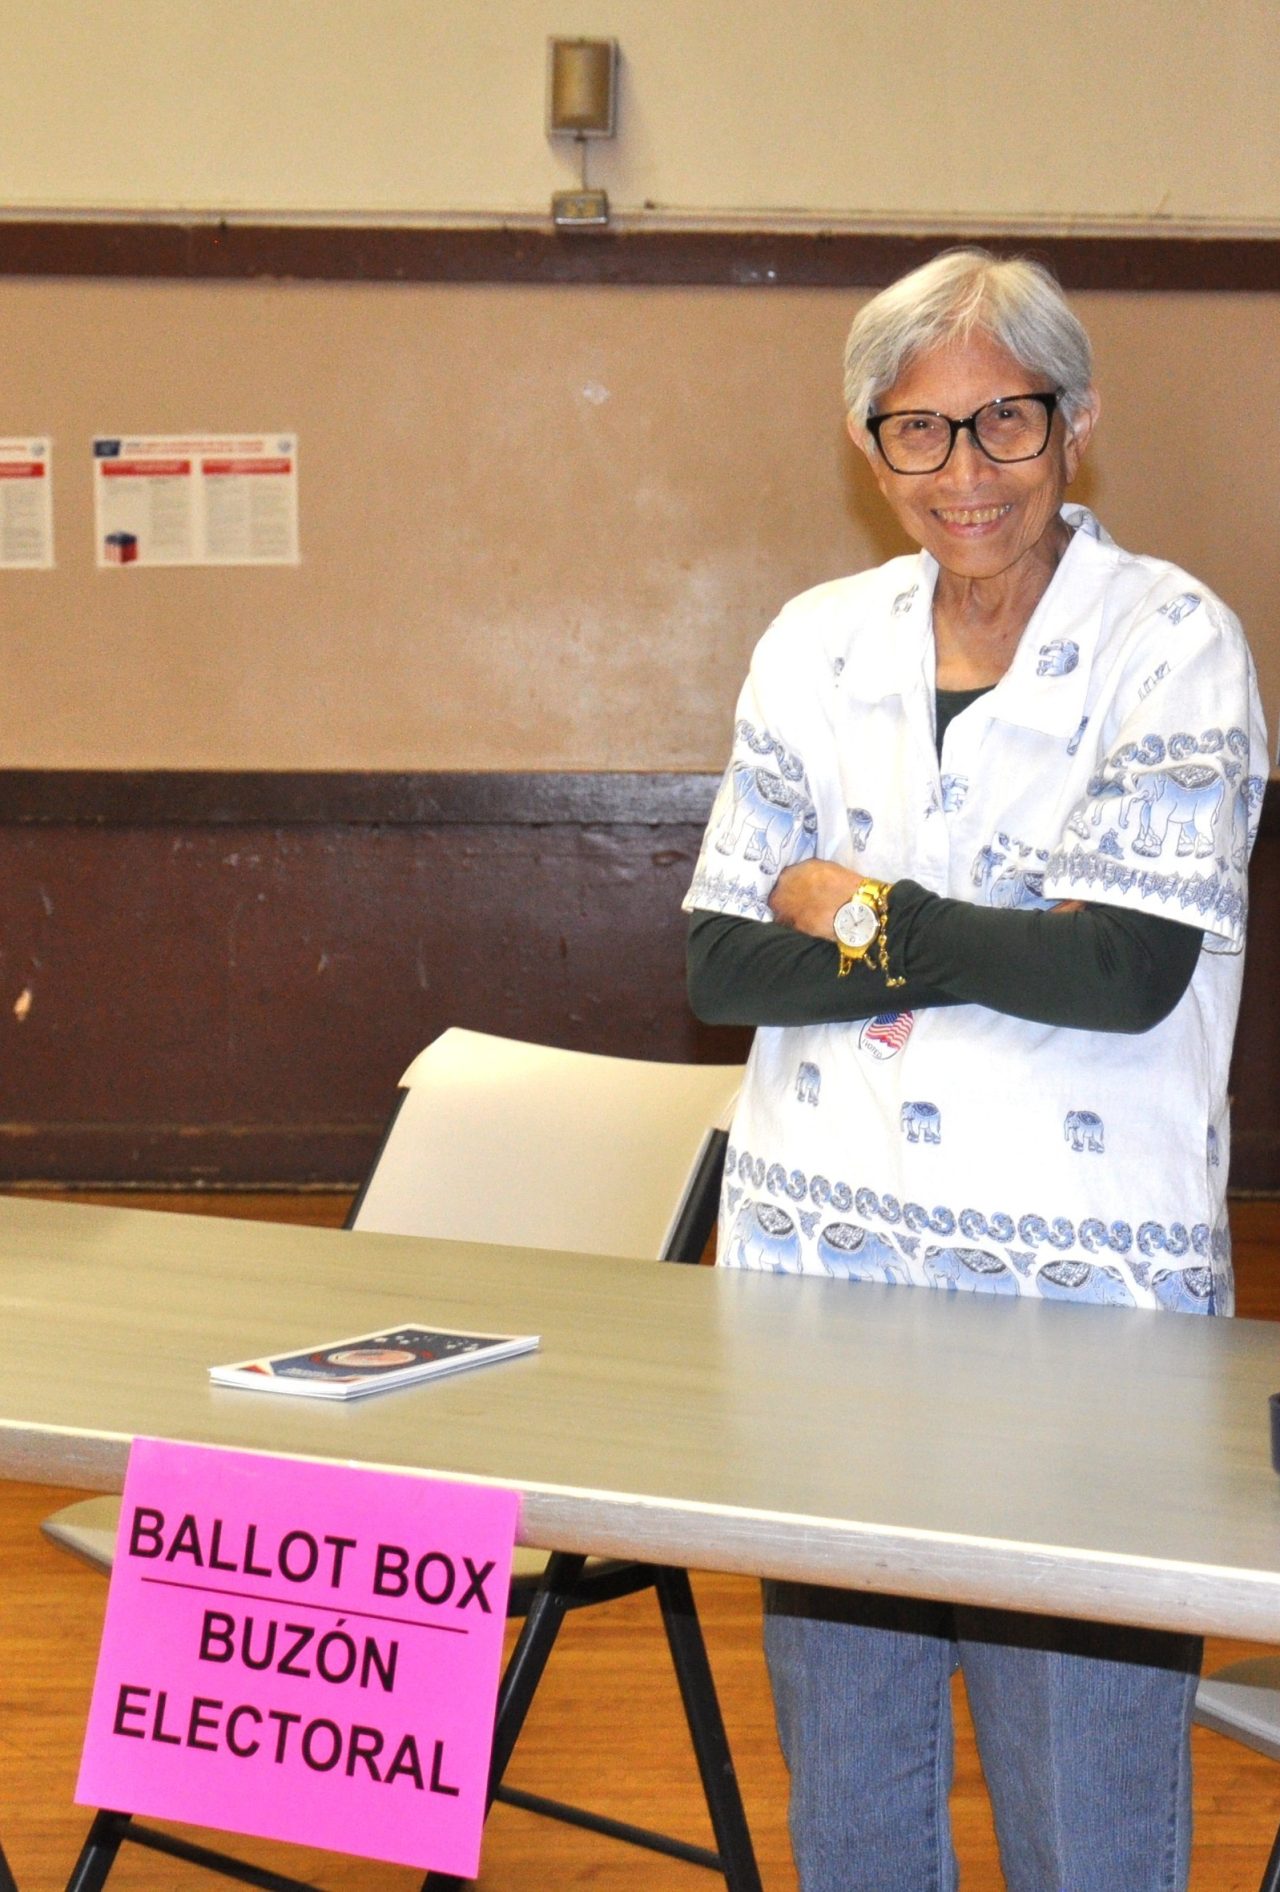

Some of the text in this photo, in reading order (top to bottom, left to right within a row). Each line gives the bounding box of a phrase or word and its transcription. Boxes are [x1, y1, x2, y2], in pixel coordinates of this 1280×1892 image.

[129, 1506, 497, 1614] BALLOT BOX
[199, 1609, 399, 1693] BUZÓN
[113, 1683, 461, 1798] ELECTORAL
